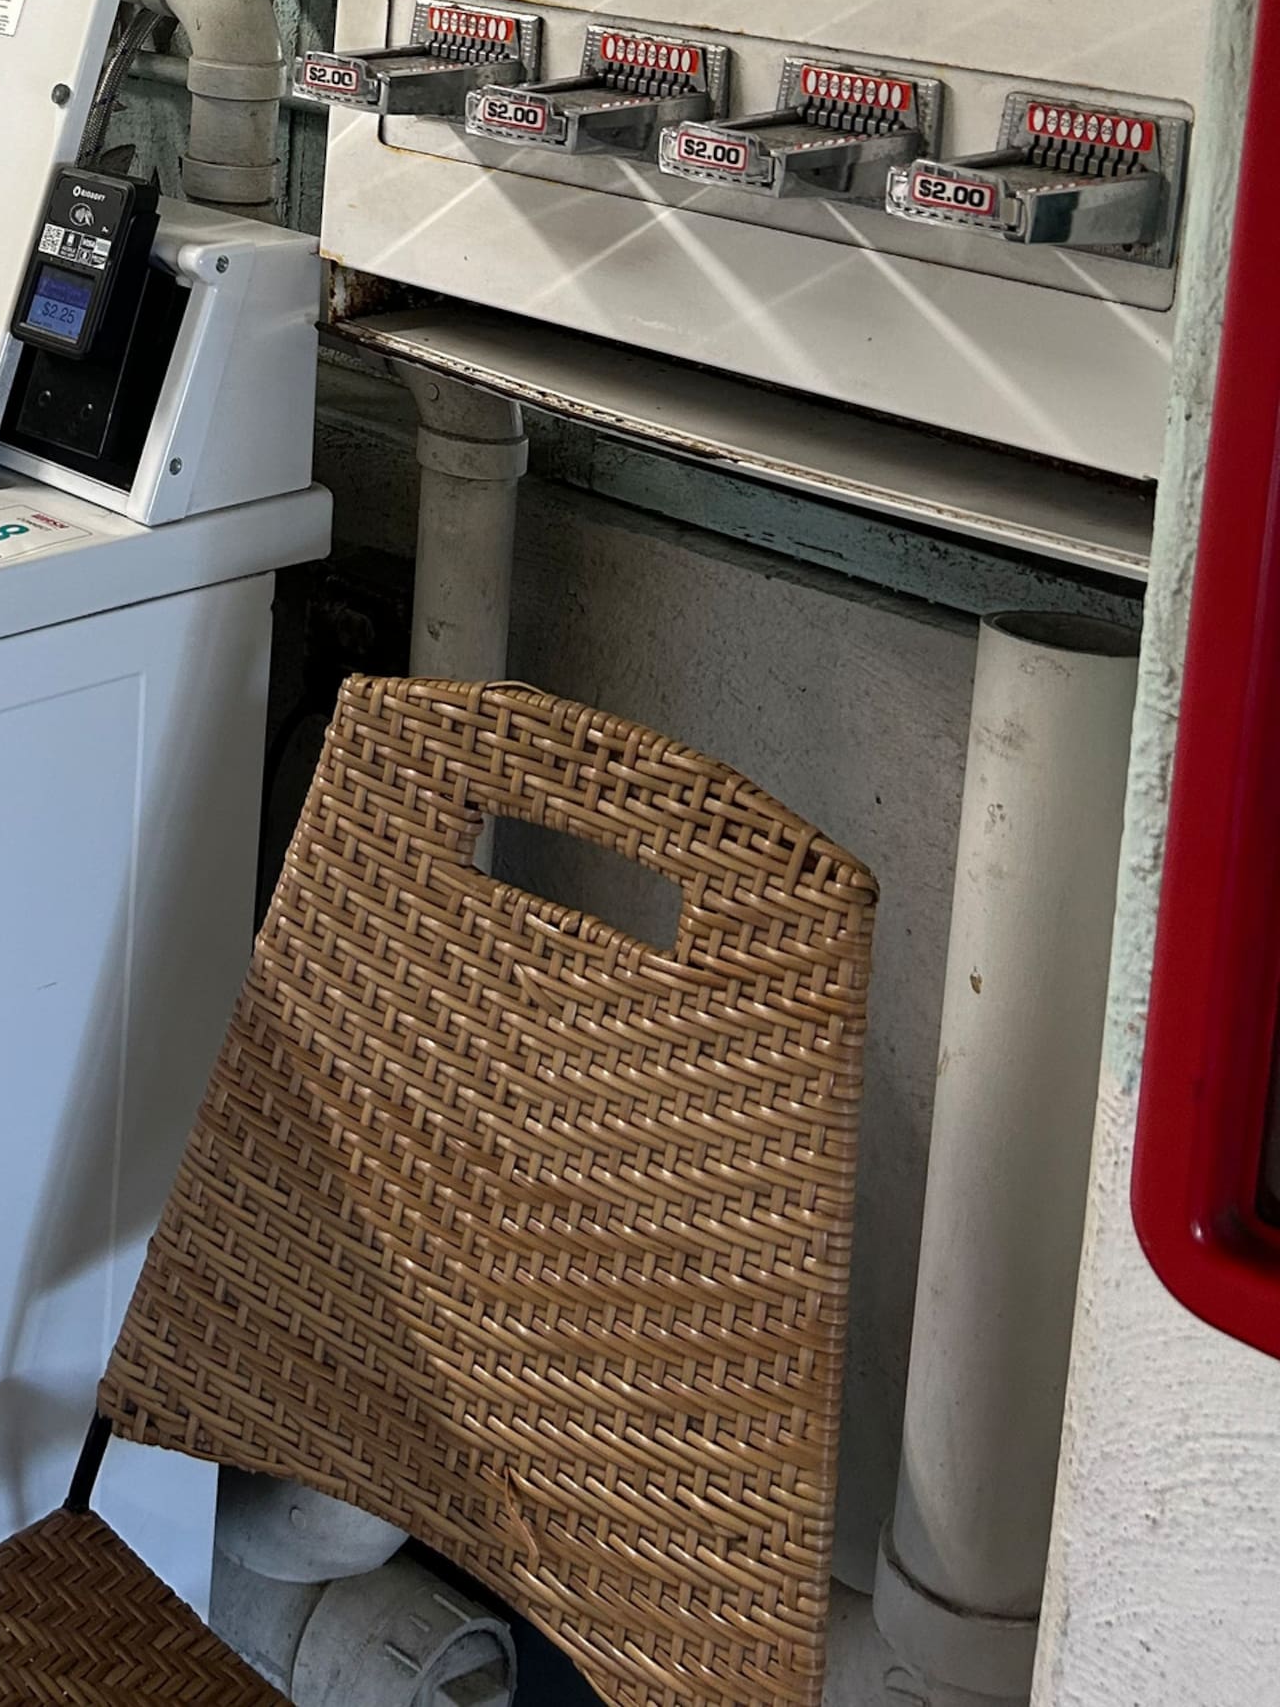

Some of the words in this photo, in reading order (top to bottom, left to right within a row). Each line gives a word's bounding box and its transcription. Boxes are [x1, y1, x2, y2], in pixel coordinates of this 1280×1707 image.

[308, 65, 354, 88] $2.00
[486, 101, 539, 126] $2.00
[682, 140, 741, 166] $2.00
[918, 178, 986, 208] $2.00
[41, 301, 76, 324] $2.25
